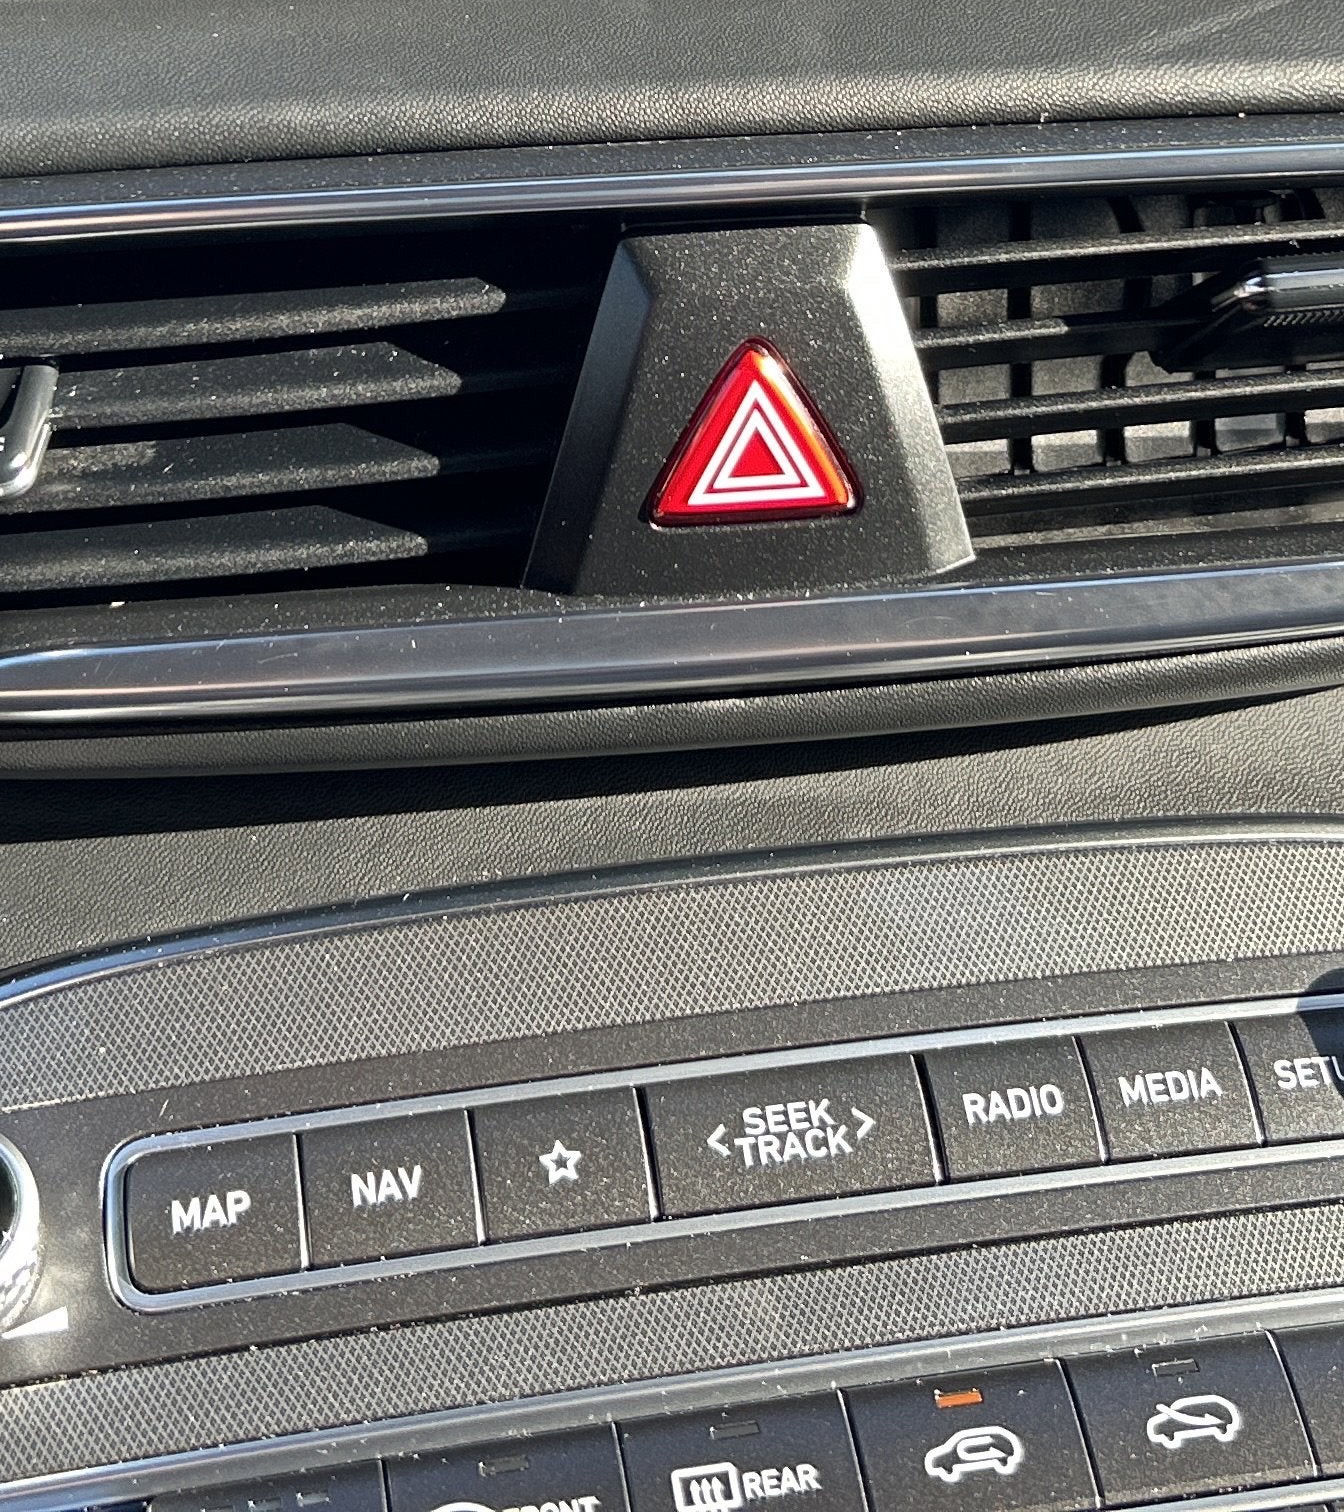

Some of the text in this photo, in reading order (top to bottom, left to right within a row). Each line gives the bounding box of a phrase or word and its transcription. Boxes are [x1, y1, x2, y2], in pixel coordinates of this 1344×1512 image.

[962, 1083, 1065, 1124] RADIO
[1117, 1066, 1224, 1107] MEDIA
[741, 1097, 838, 1137] SEEK
[733, 1124, 854, 1169] TRACK
[350, 1163, 423, 1208] NAV
[170, 1189, 252, 1235] MAP
[741, 1463, 823, 1501] REAR
